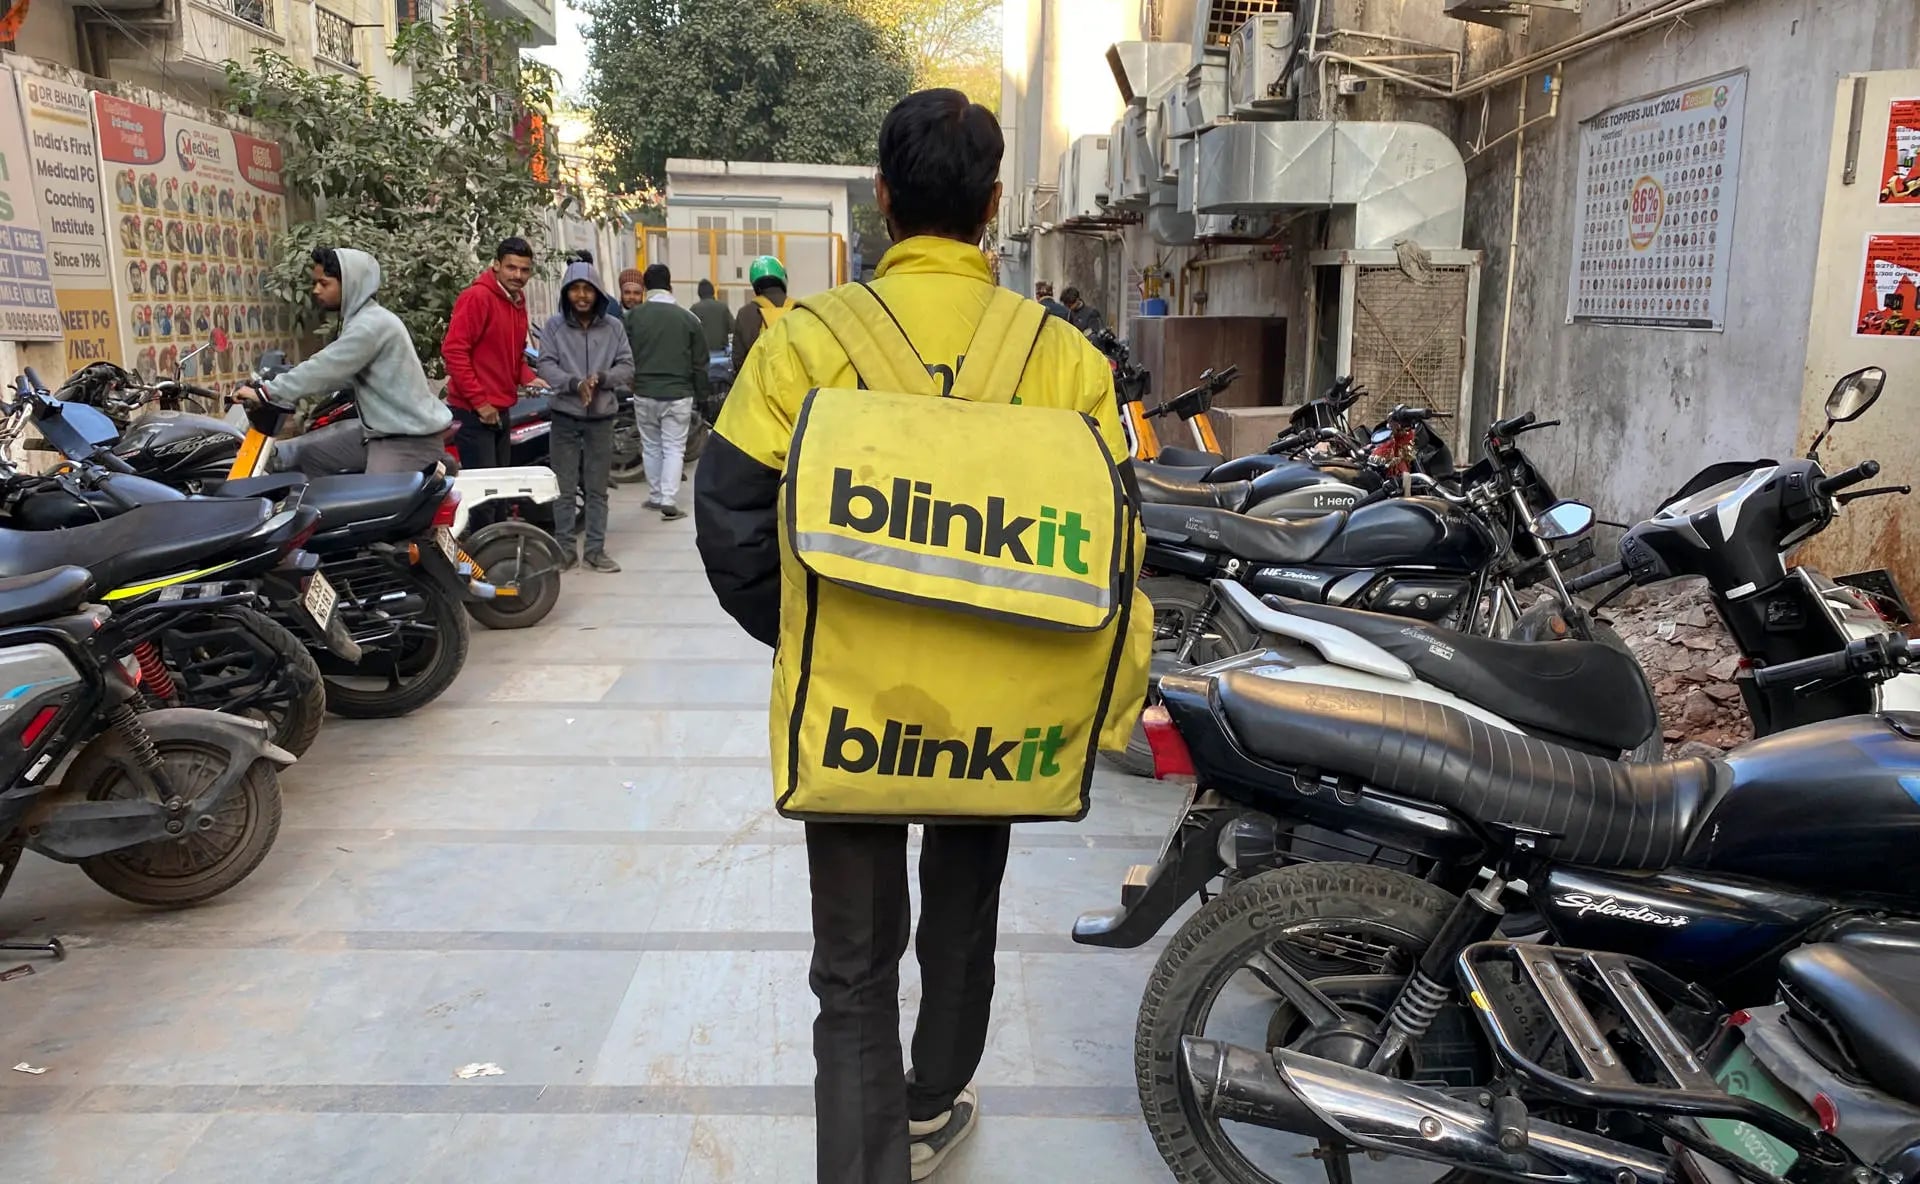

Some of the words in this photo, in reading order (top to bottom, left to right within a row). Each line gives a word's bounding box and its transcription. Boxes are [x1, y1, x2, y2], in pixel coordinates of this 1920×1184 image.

[39, 86, 53, 101] DR
[54, 89, 87, 109] BHATIA
[1610, 108, 1641, 127] TOPPERS
[1641, 103, 1660, 119] JULY
[1660, 98, 1681, 114] 2024
[33, 129, 69, 152] India's
[70, 136, 92, 156] First
[36, 158, 79, 181] Medical
[80, 165, 95, 183] PG
[45, 188, 95, 214] Coaching
[1633, 186, 1659, 213] 86%
[51, 216, 95, 235] Institute
[53, 252, 80, 268] Since
[80, 253, 101, 268] 1996
[60, 310, 88, 330] NEET
[92, 310, 110, 329] PG
[1327, 496, 1355, 506] Hero
[829, 467, 1091, 574] blinkit
[822, 706, 1066, 782] blinkit
[1248, 897, 1323, 931] CEAT
[1153, 1049, 1218, 1184] MILAZE
